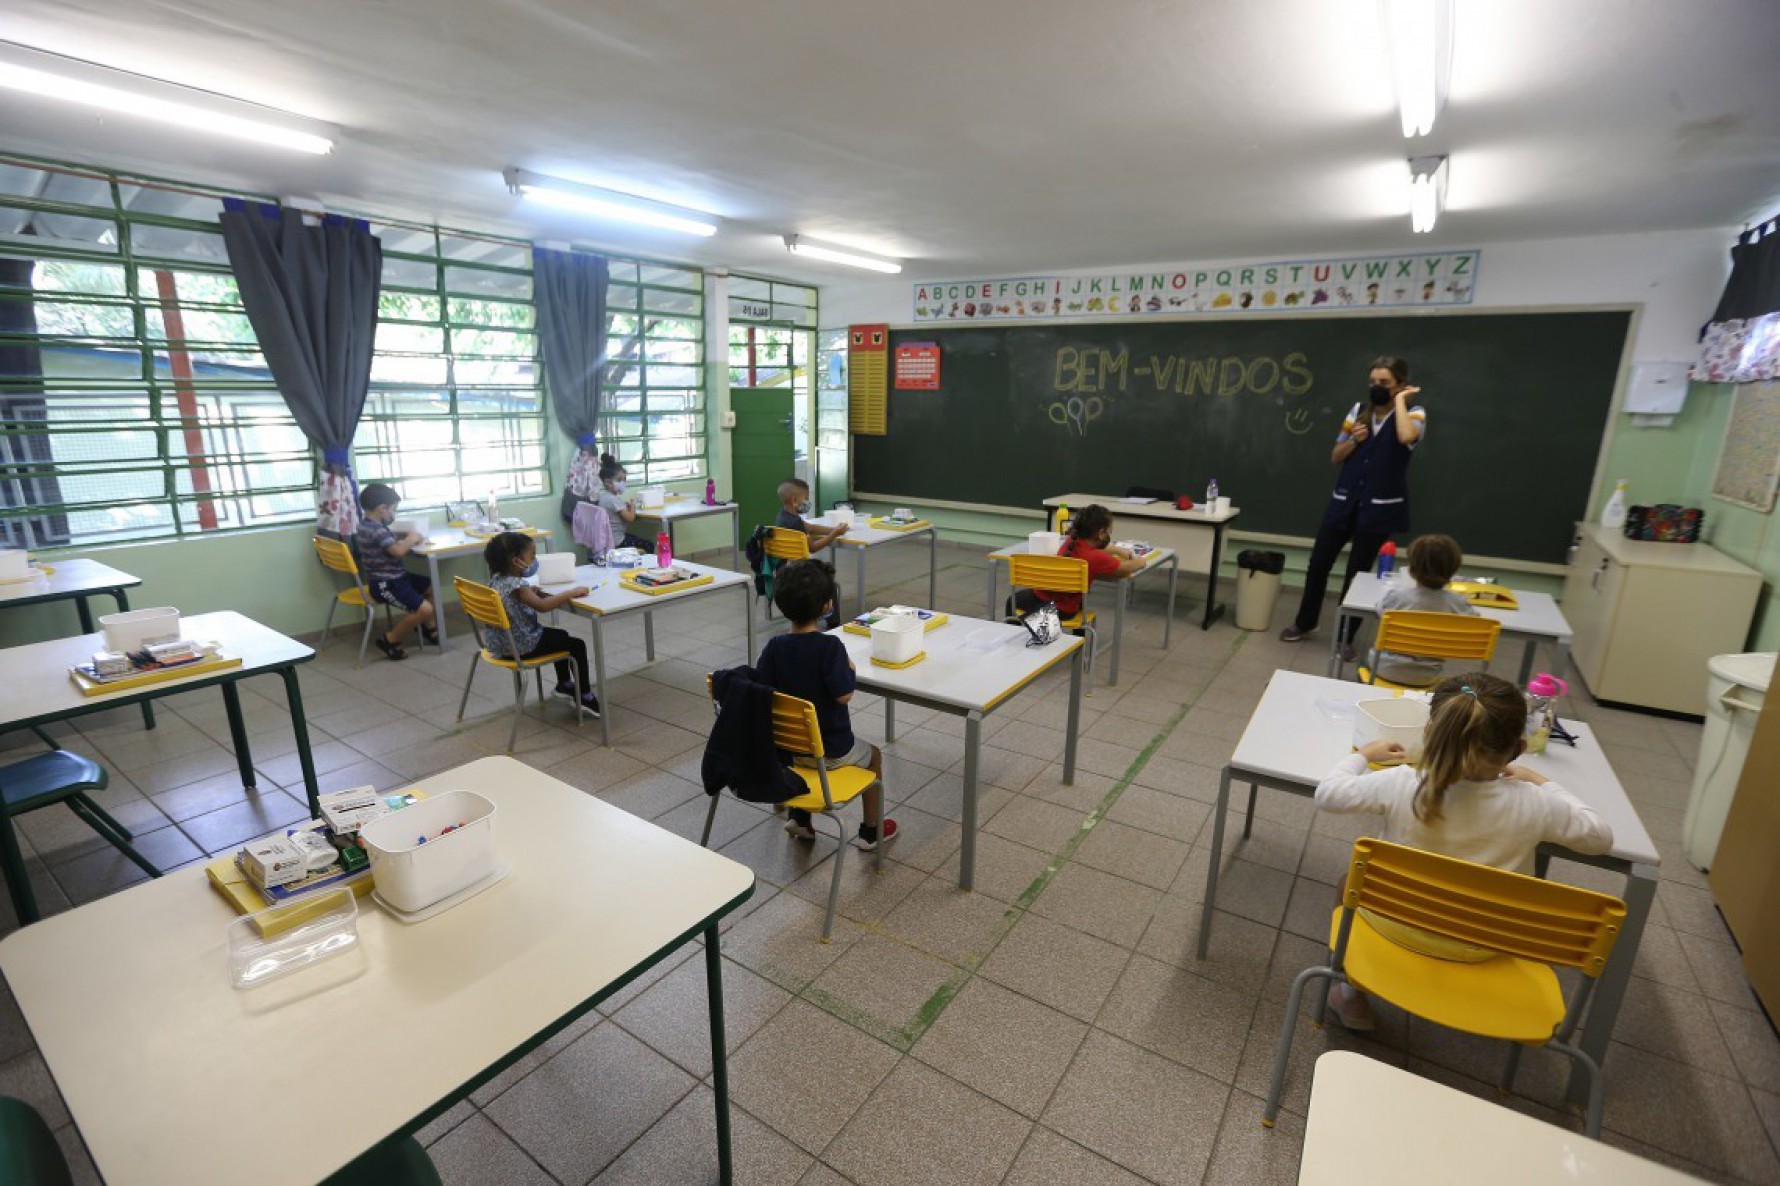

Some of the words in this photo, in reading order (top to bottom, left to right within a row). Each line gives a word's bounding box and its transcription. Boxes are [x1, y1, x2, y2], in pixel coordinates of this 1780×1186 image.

[918, 285, 928, 300] A
[933, 287, 942, 300] B
[949, 285, 959, 299] C
[965, 285, 976, 298] D
[982, 284, 991, 298] E
[999, 283, 1008, 296] F
[1015, 282, 1027, 296] G
[1034, 281, 1045, 295] H
[1055, 281, 1060, 294] I
[1072, 279, 1081, 294] J
[1091, 279, 1102, 292] K
[1111, 277, 1121, 292] L
[1129, 276, 1143, 291] M
[1152, 275, 1164, 289] N
[1172, 273, 1187, 289] O
[1195, 272, 1207, 288] P
[1216, 270, 1232, 286] Q
[1240, 268, 1254, 284] R
[1265, 268, 1277, 284] S
[1290, 265, 1304, 283] T
[1314, 265, 1330, 282] U
[1341, 263, 1357, 280] V
[1366, 262, 1389, 279] W
[1396, 259, 1412, 277] X
[1425, 257, 1441, 276] Y
[1453, 256, 1471, 275] Z
[1054, 346, 1313, 395] BEM-VINDOS
